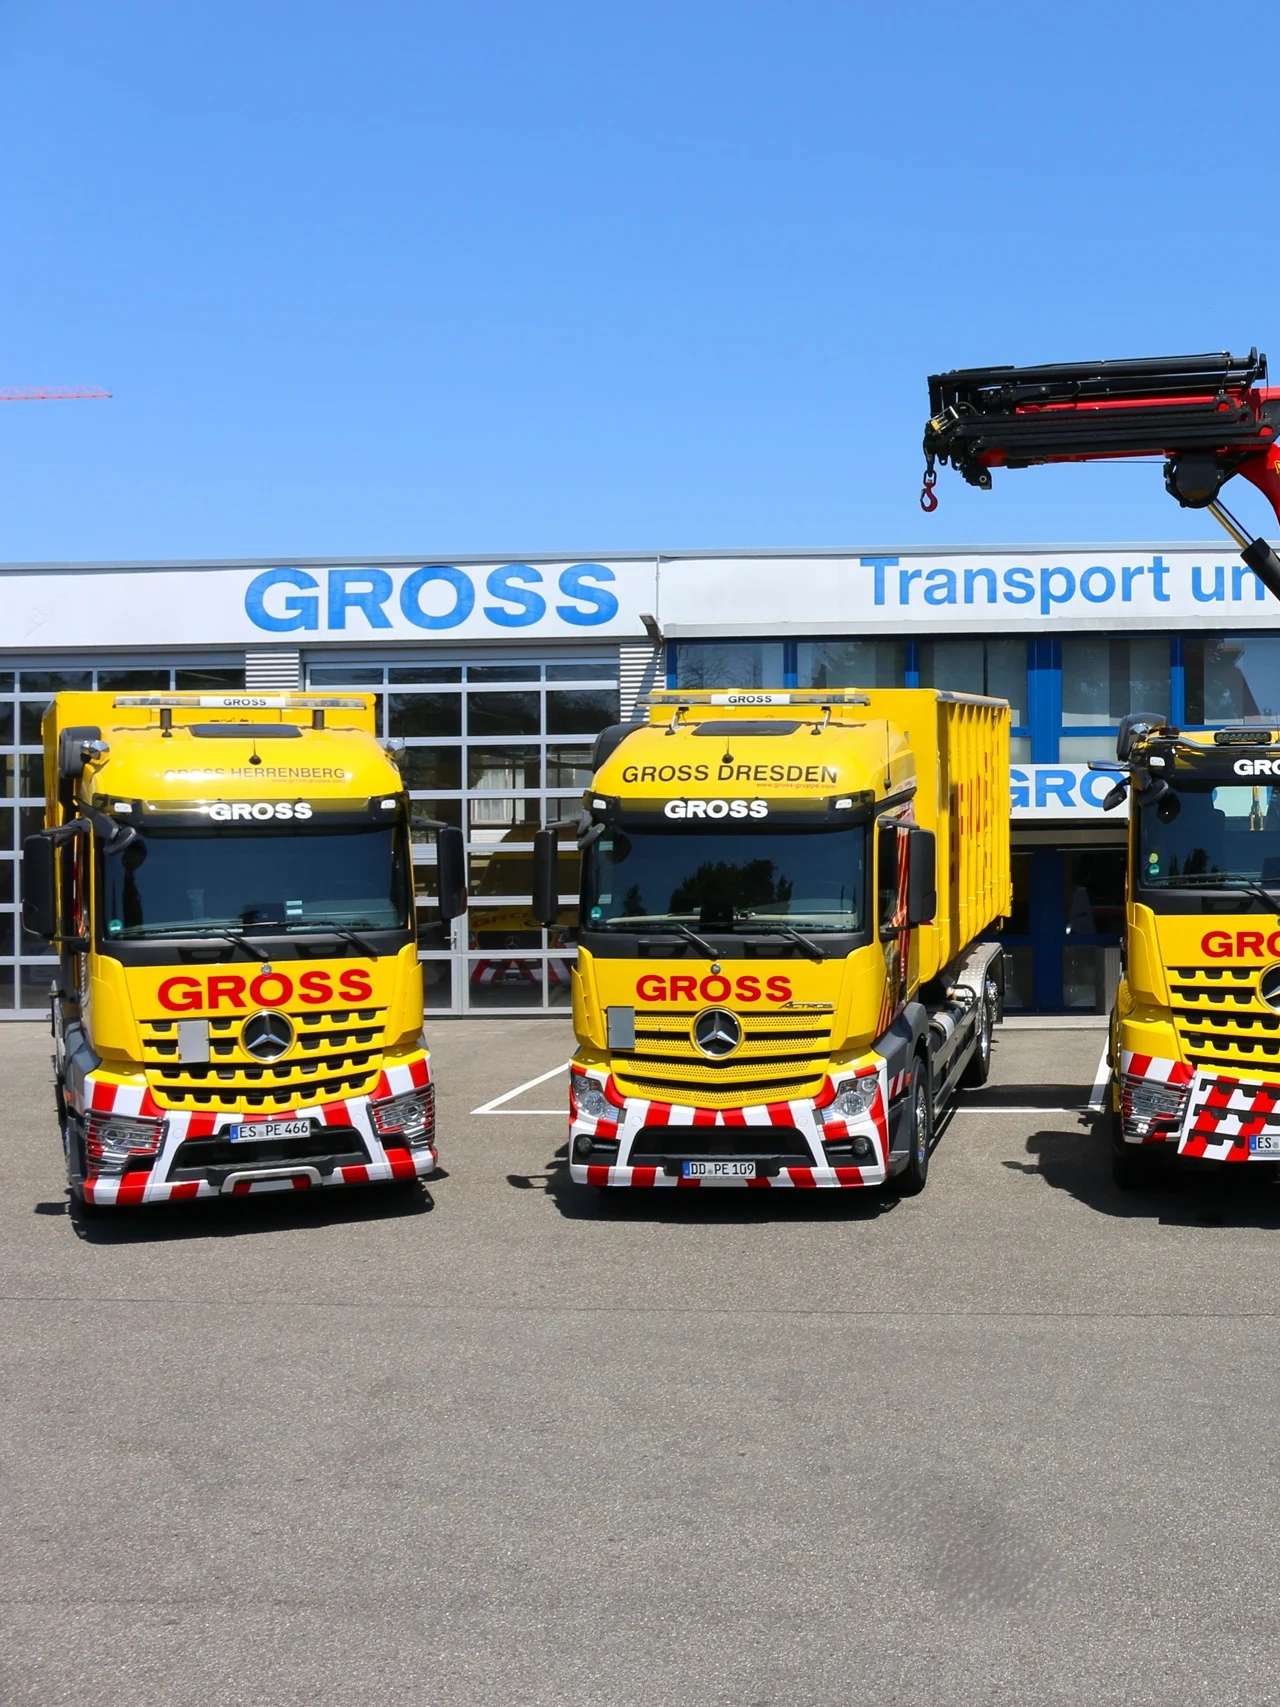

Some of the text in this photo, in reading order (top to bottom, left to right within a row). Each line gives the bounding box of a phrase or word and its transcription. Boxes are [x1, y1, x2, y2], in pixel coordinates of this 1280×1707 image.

[860, 556, 1170, 615] Transport
[244, 562, 620, 632] GROSS
[223, 698, 267, 706] GROSS
[728, 695, 772, 703] GROSS
[231, 767, 346, 779] HERRENBERG
[622, 764, 838, 783] GROSS DRESDEN
[756, 781, 837, 790] www.gross-gruppe.com
[209, 802, 313, 821] GROSS
[664, 799, 769, 819] GROSS
[157, 968, 373, 1011] GROSS
[636, 974, 792, 1003] GROSS
[240, 1122, 308, 1138] ES PE 466
[1257, 1136, 1272, 1149] ES
[691, 1163, 755, 1175] DD PE 109
